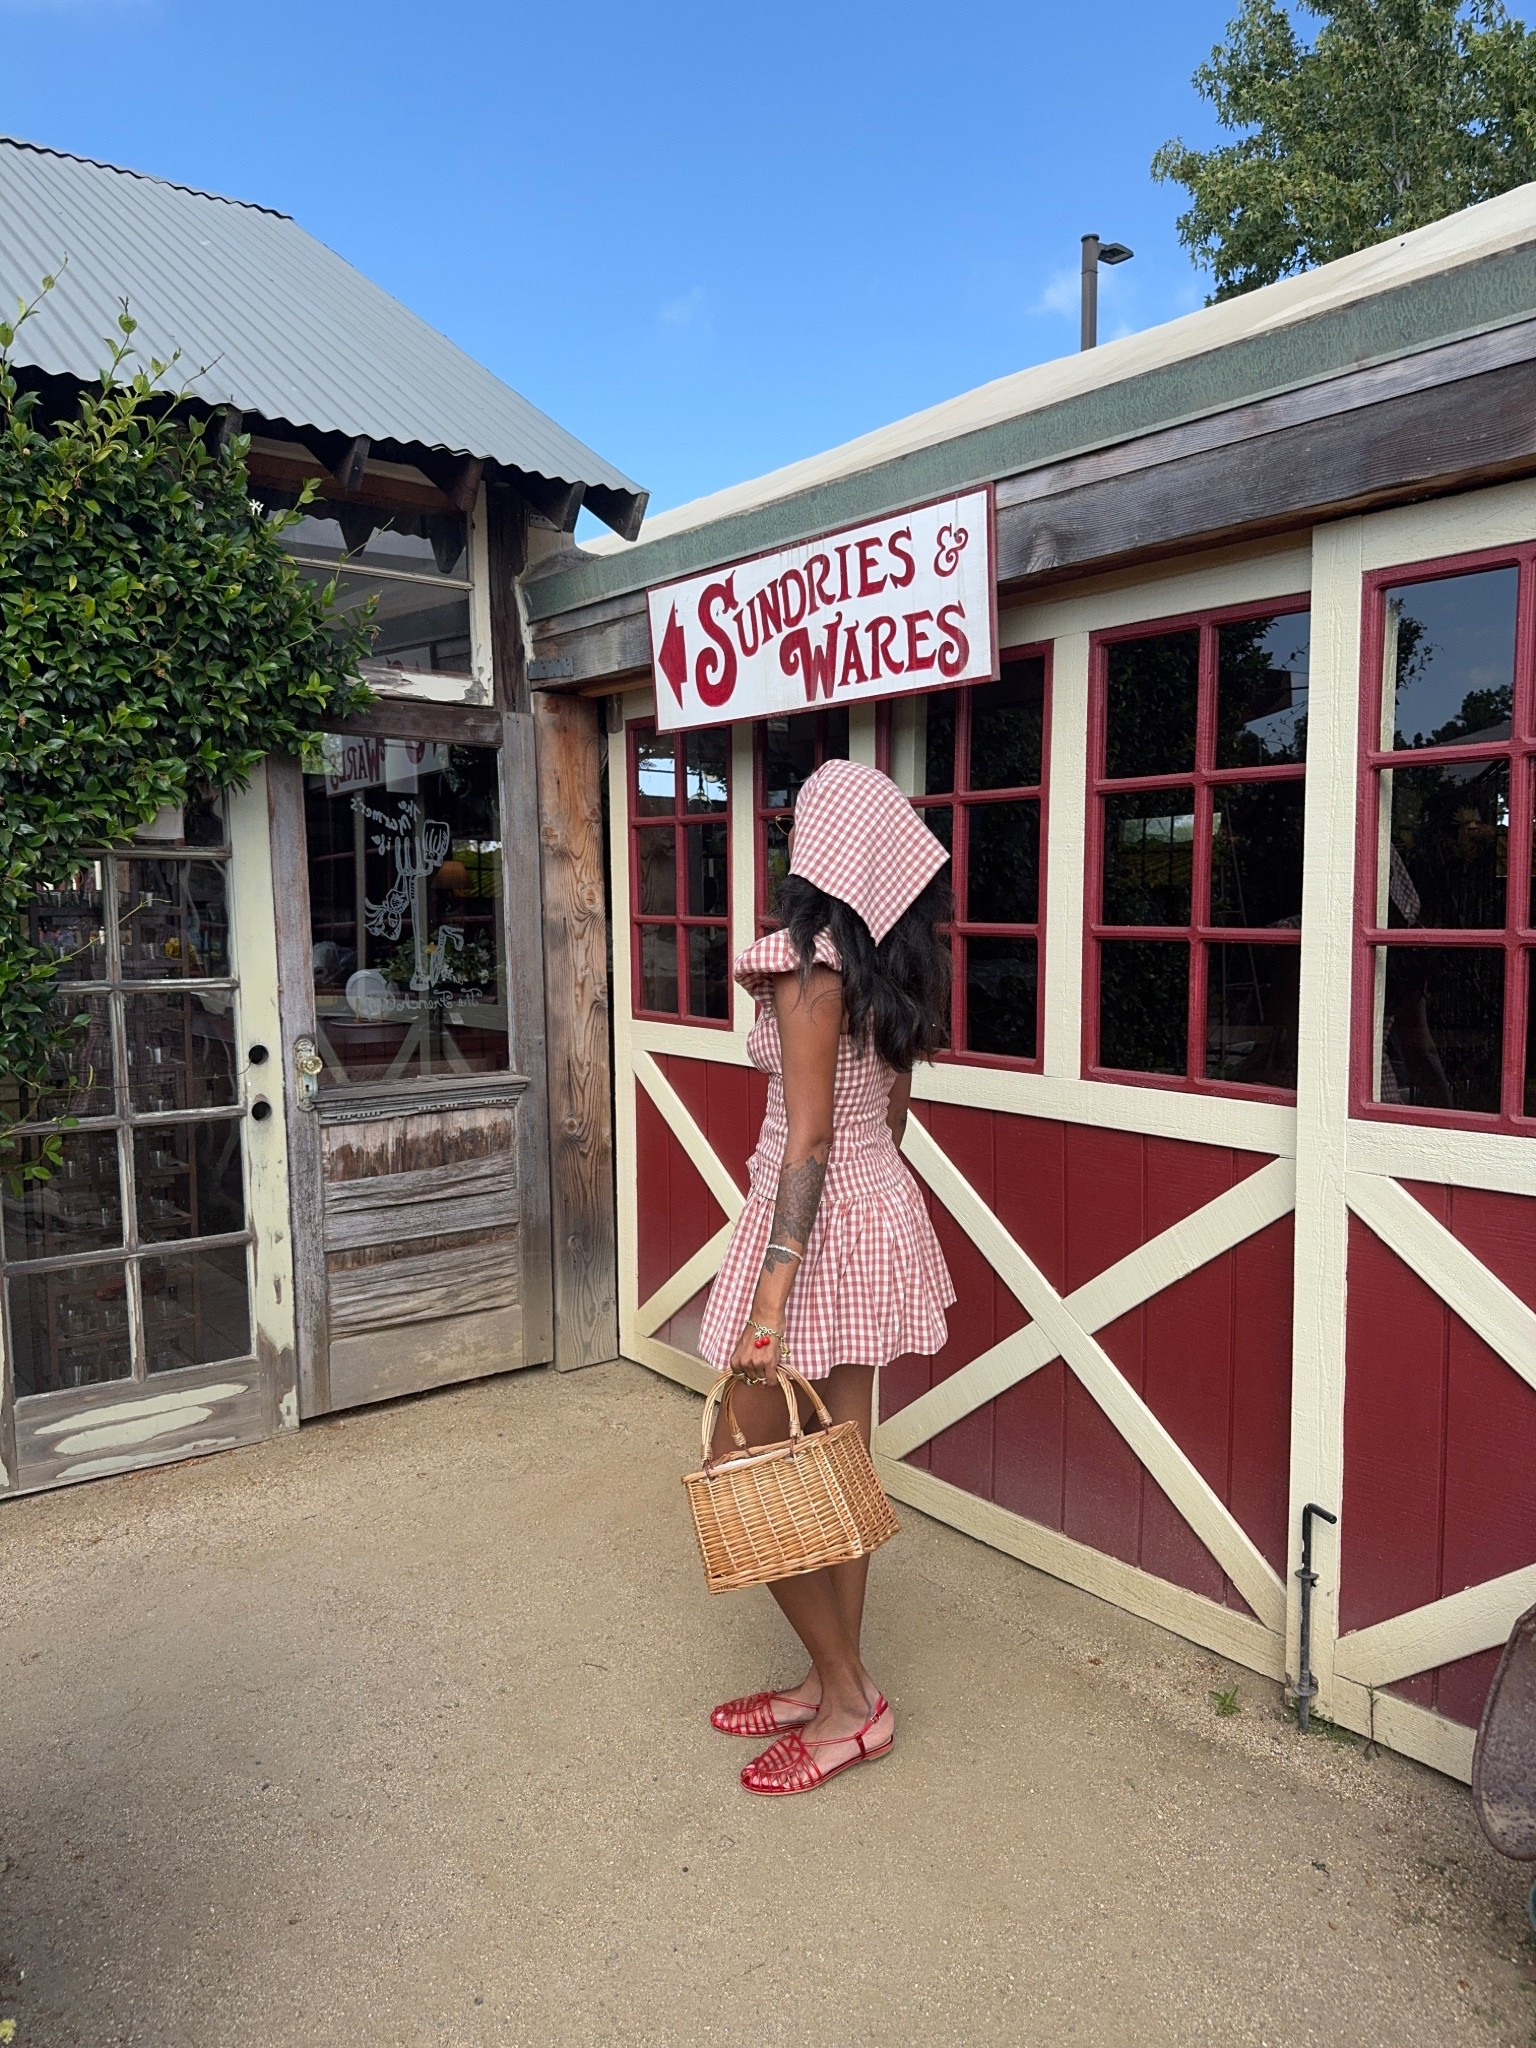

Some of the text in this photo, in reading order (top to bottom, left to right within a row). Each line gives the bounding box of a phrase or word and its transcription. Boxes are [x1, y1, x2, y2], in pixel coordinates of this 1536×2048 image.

[695, 523, 969, 707] SUNDRIES &
[779, 600, 970, 702] WARES
